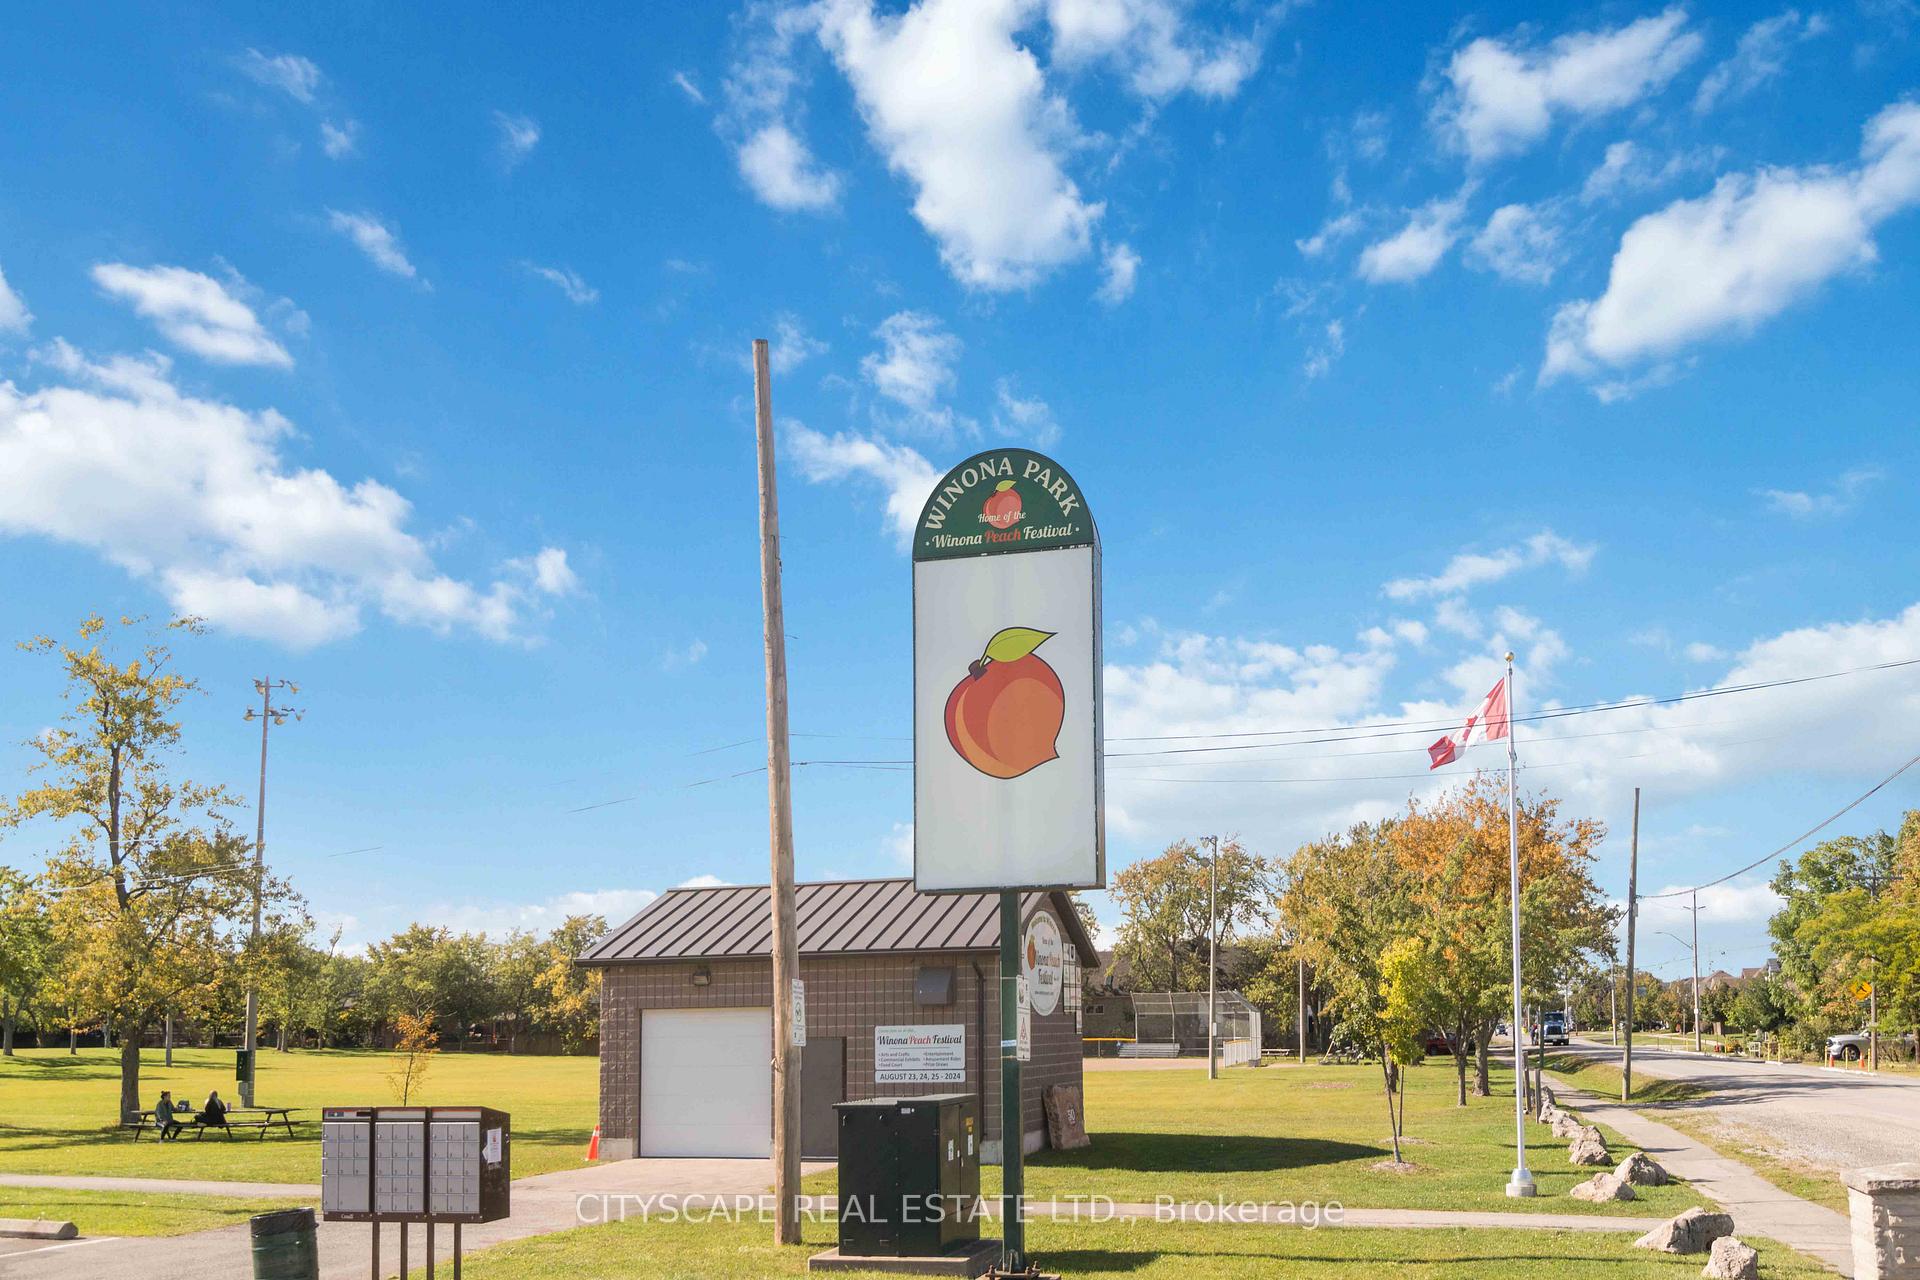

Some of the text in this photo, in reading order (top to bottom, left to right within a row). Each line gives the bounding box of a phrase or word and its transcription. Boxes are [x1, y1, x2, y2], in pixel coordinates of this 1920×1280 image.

[925, 457, 1079, 529] WINONA PARK
[978, 511, 1026, 523] Home of the
[932, 523, 1072, 548] Winona Peach Festival
[877, 1034, 962, 1045] Winona Peach Festival
[880, 1073, 906, 1081] AUGUST
[908, 1073, 918, 1081] 23,
[919, 1073, 930, 1081] 24,
[931, 1072, 940, 1080] 25
[945, 1072, 961, 1080] 2024
